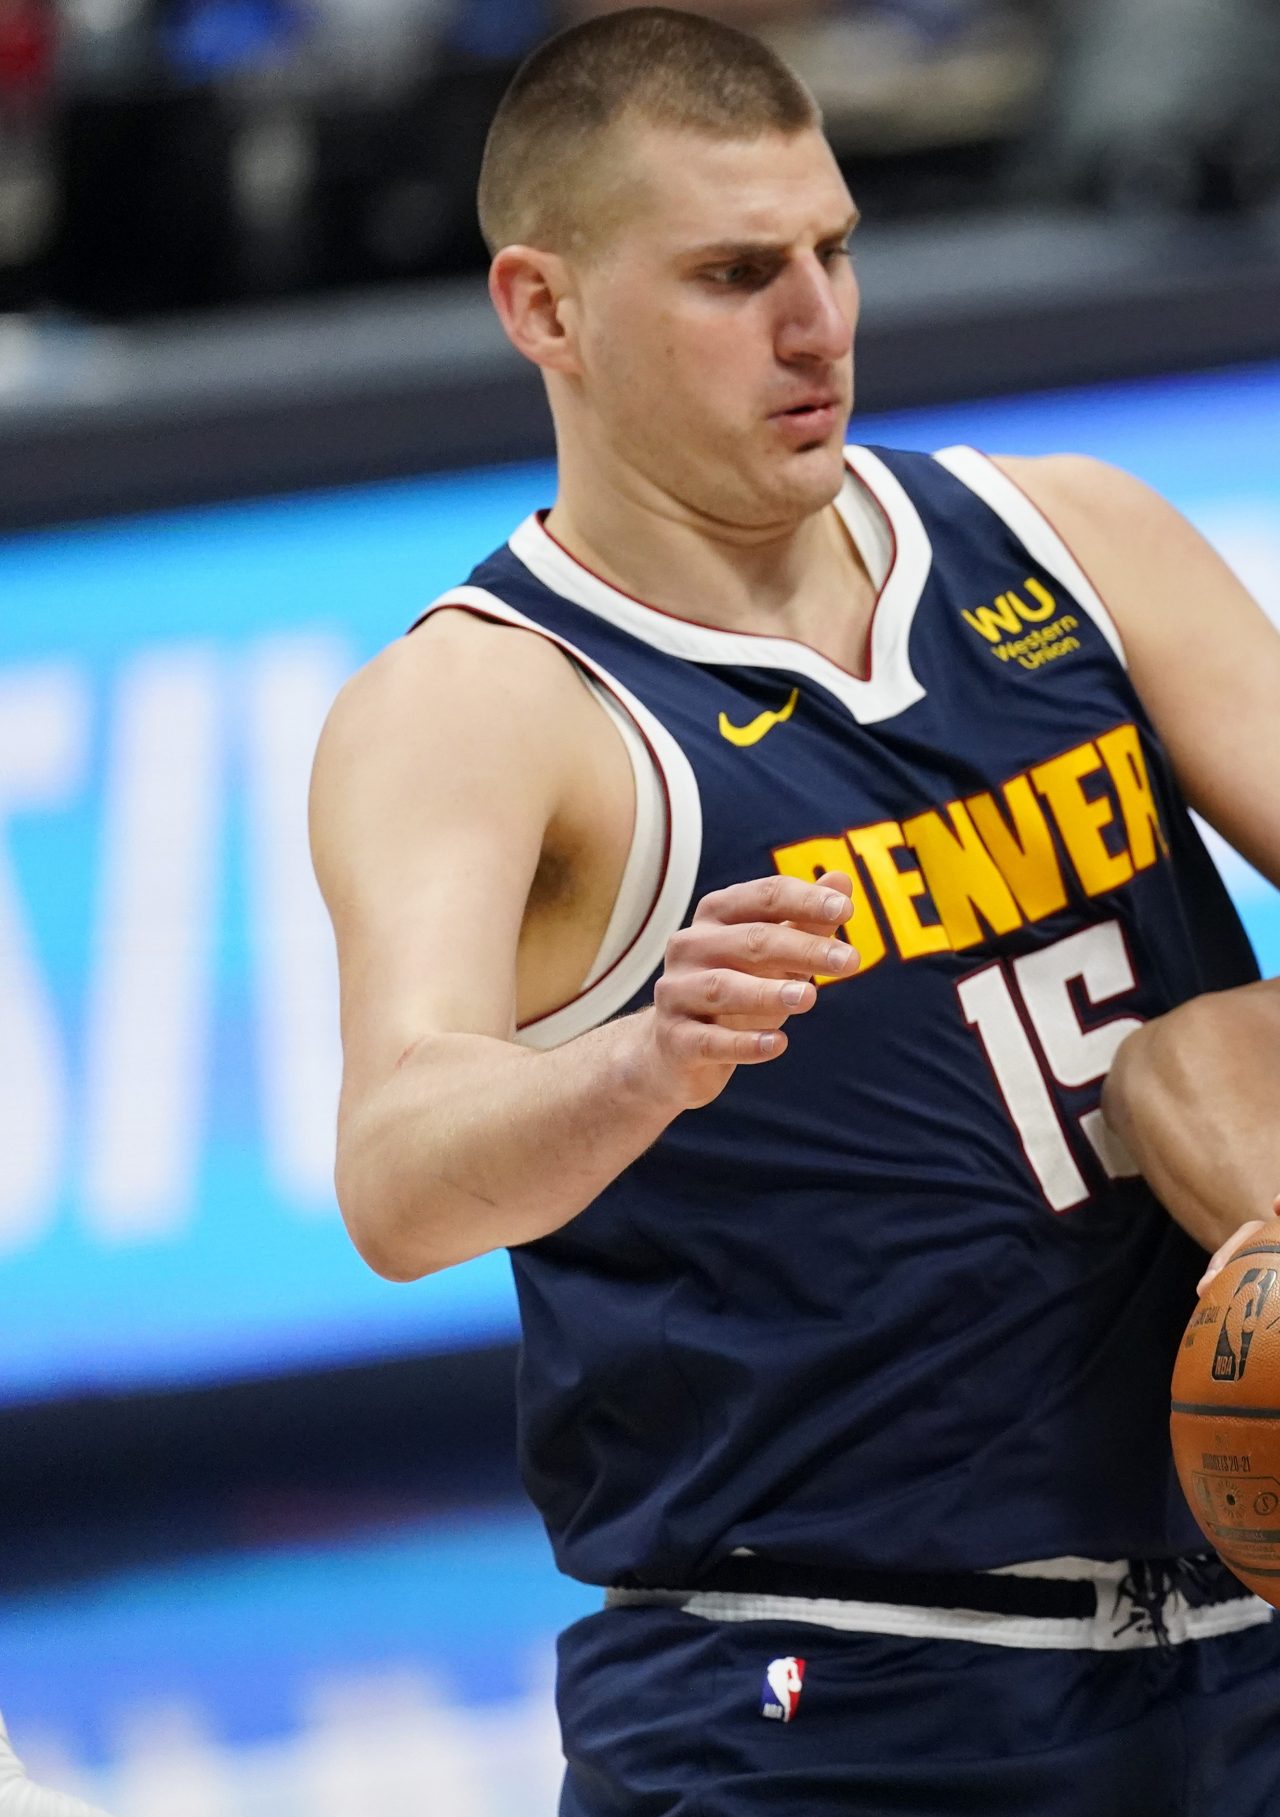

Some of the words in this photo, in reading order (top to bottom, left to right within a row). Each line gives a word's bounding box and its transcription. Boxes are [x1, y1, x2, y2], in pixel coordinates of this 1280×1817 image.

[961, 577, 1056, 643] WU
[991, 614, 1079, 662] Western
[1017, 636, 1080, 669] Union
[773, 722, 1171, 988] DENVER
[955, 919, 1144, 1213] 15
[1215, 1355, 1232, 1376] NBA
